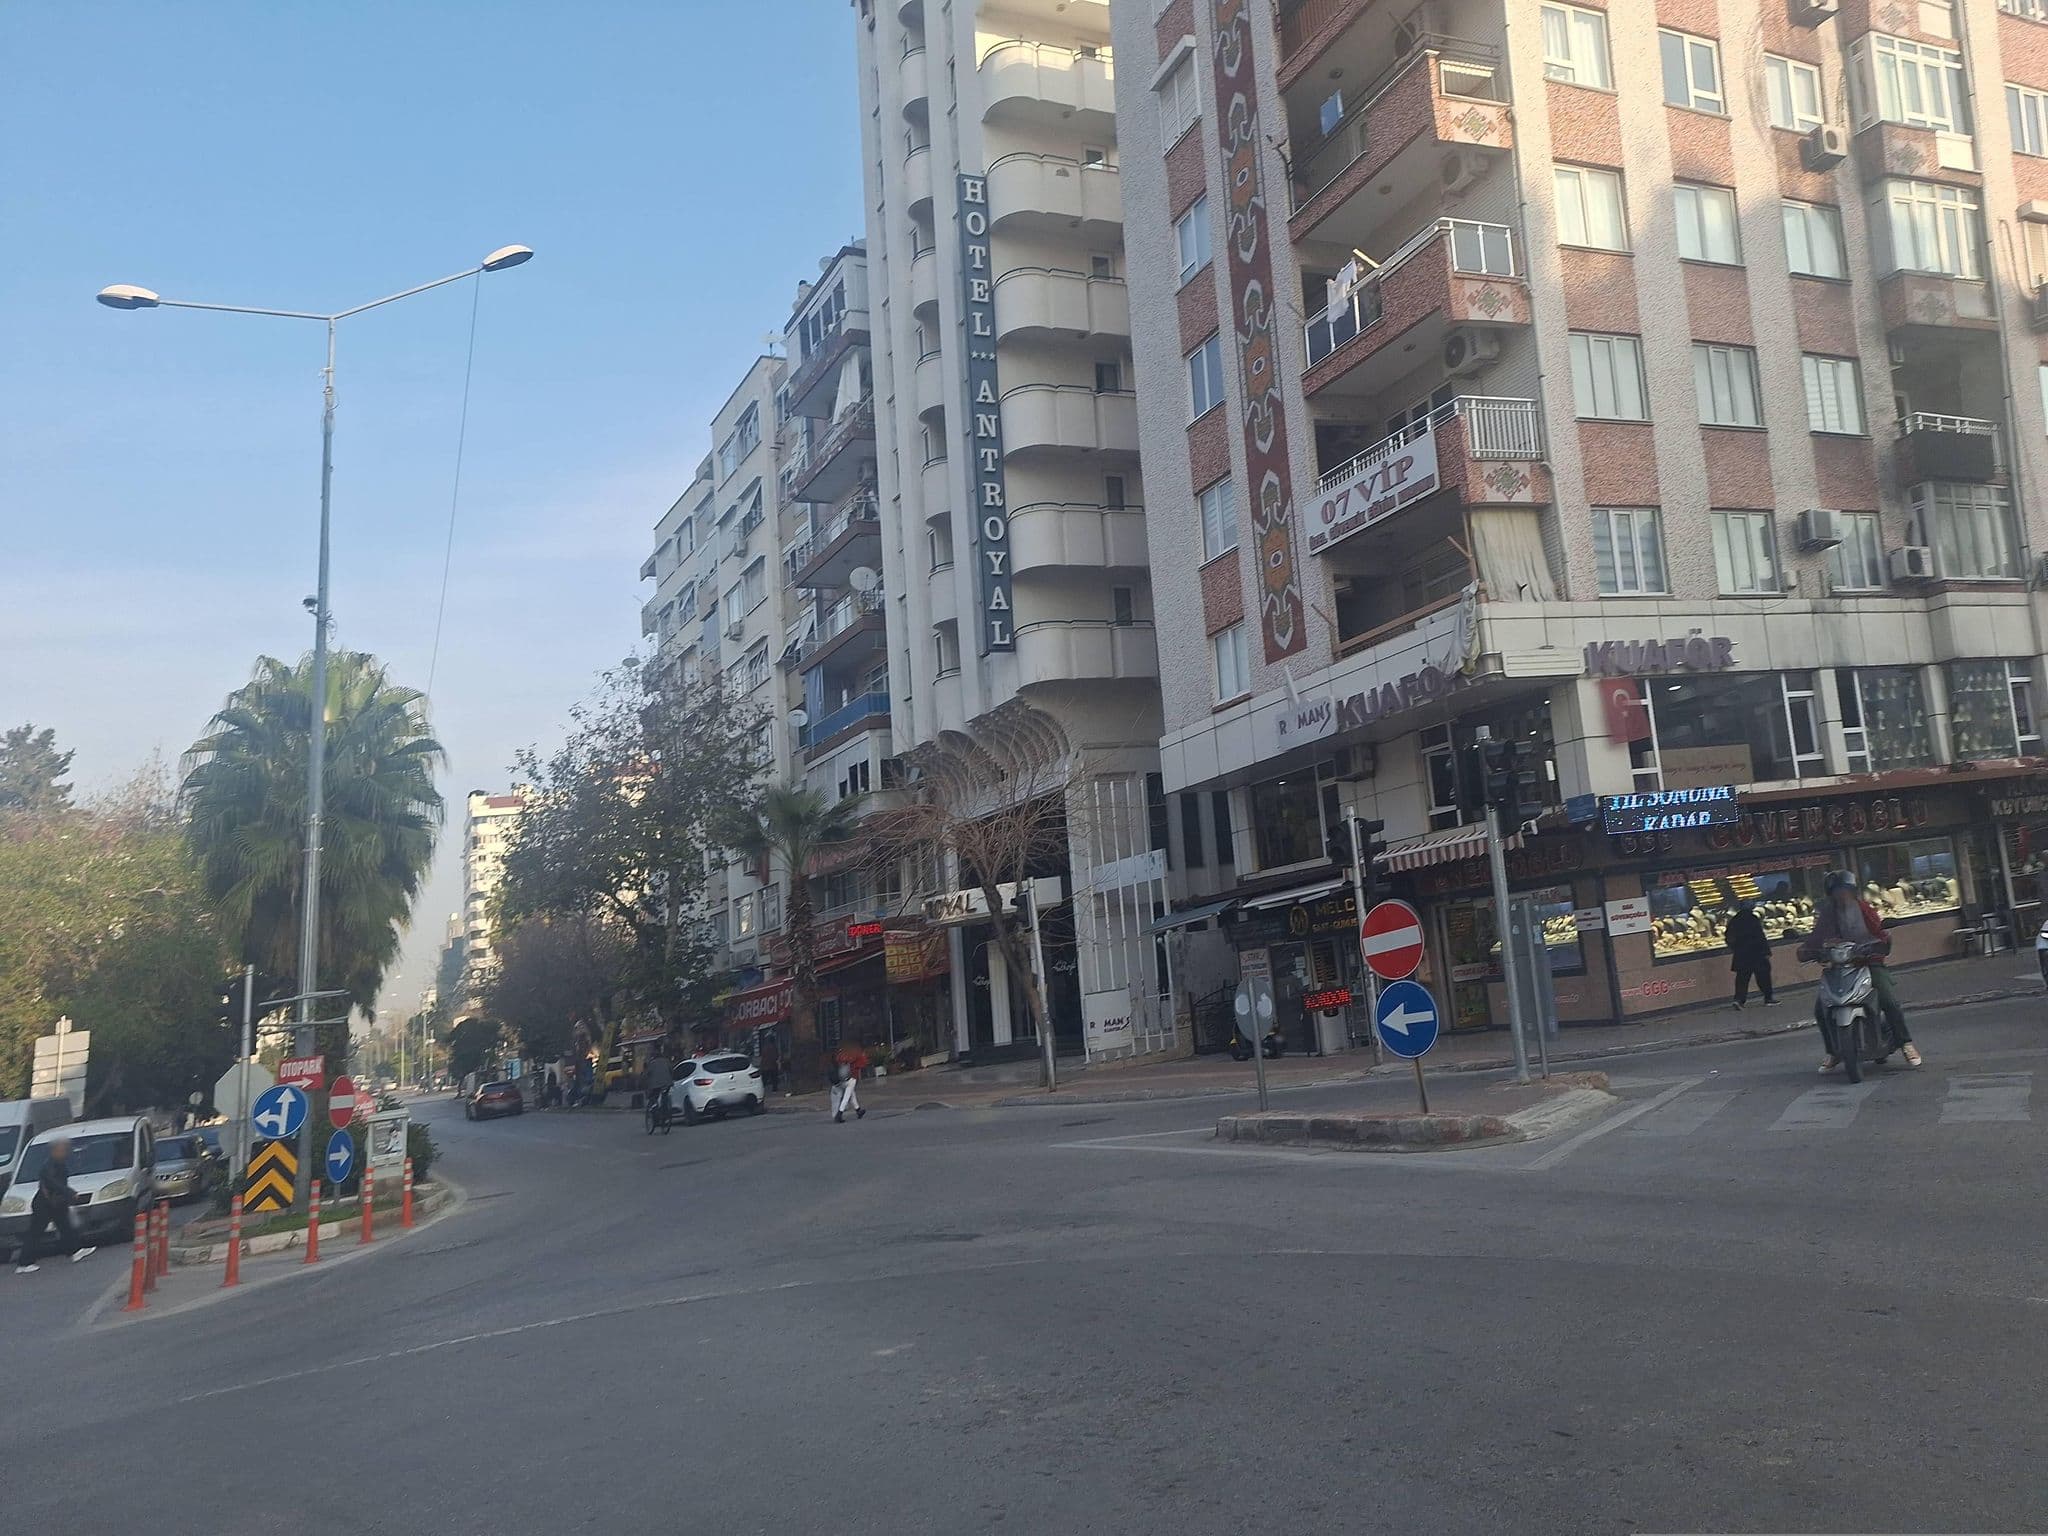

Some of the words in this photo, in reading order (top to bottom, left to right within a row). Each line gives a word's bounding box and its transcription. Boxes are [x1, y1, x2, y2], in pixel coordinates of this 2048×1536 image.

[962, 178, 991, 338] HOTEL
[975, 380, 1011, 646] ANTROYAL
[1321, 488, 1350, 525] 07
[1584, 628, 1734, 673] KUAFÖR
[280, 1058, 322, 1078] OTOPARK
